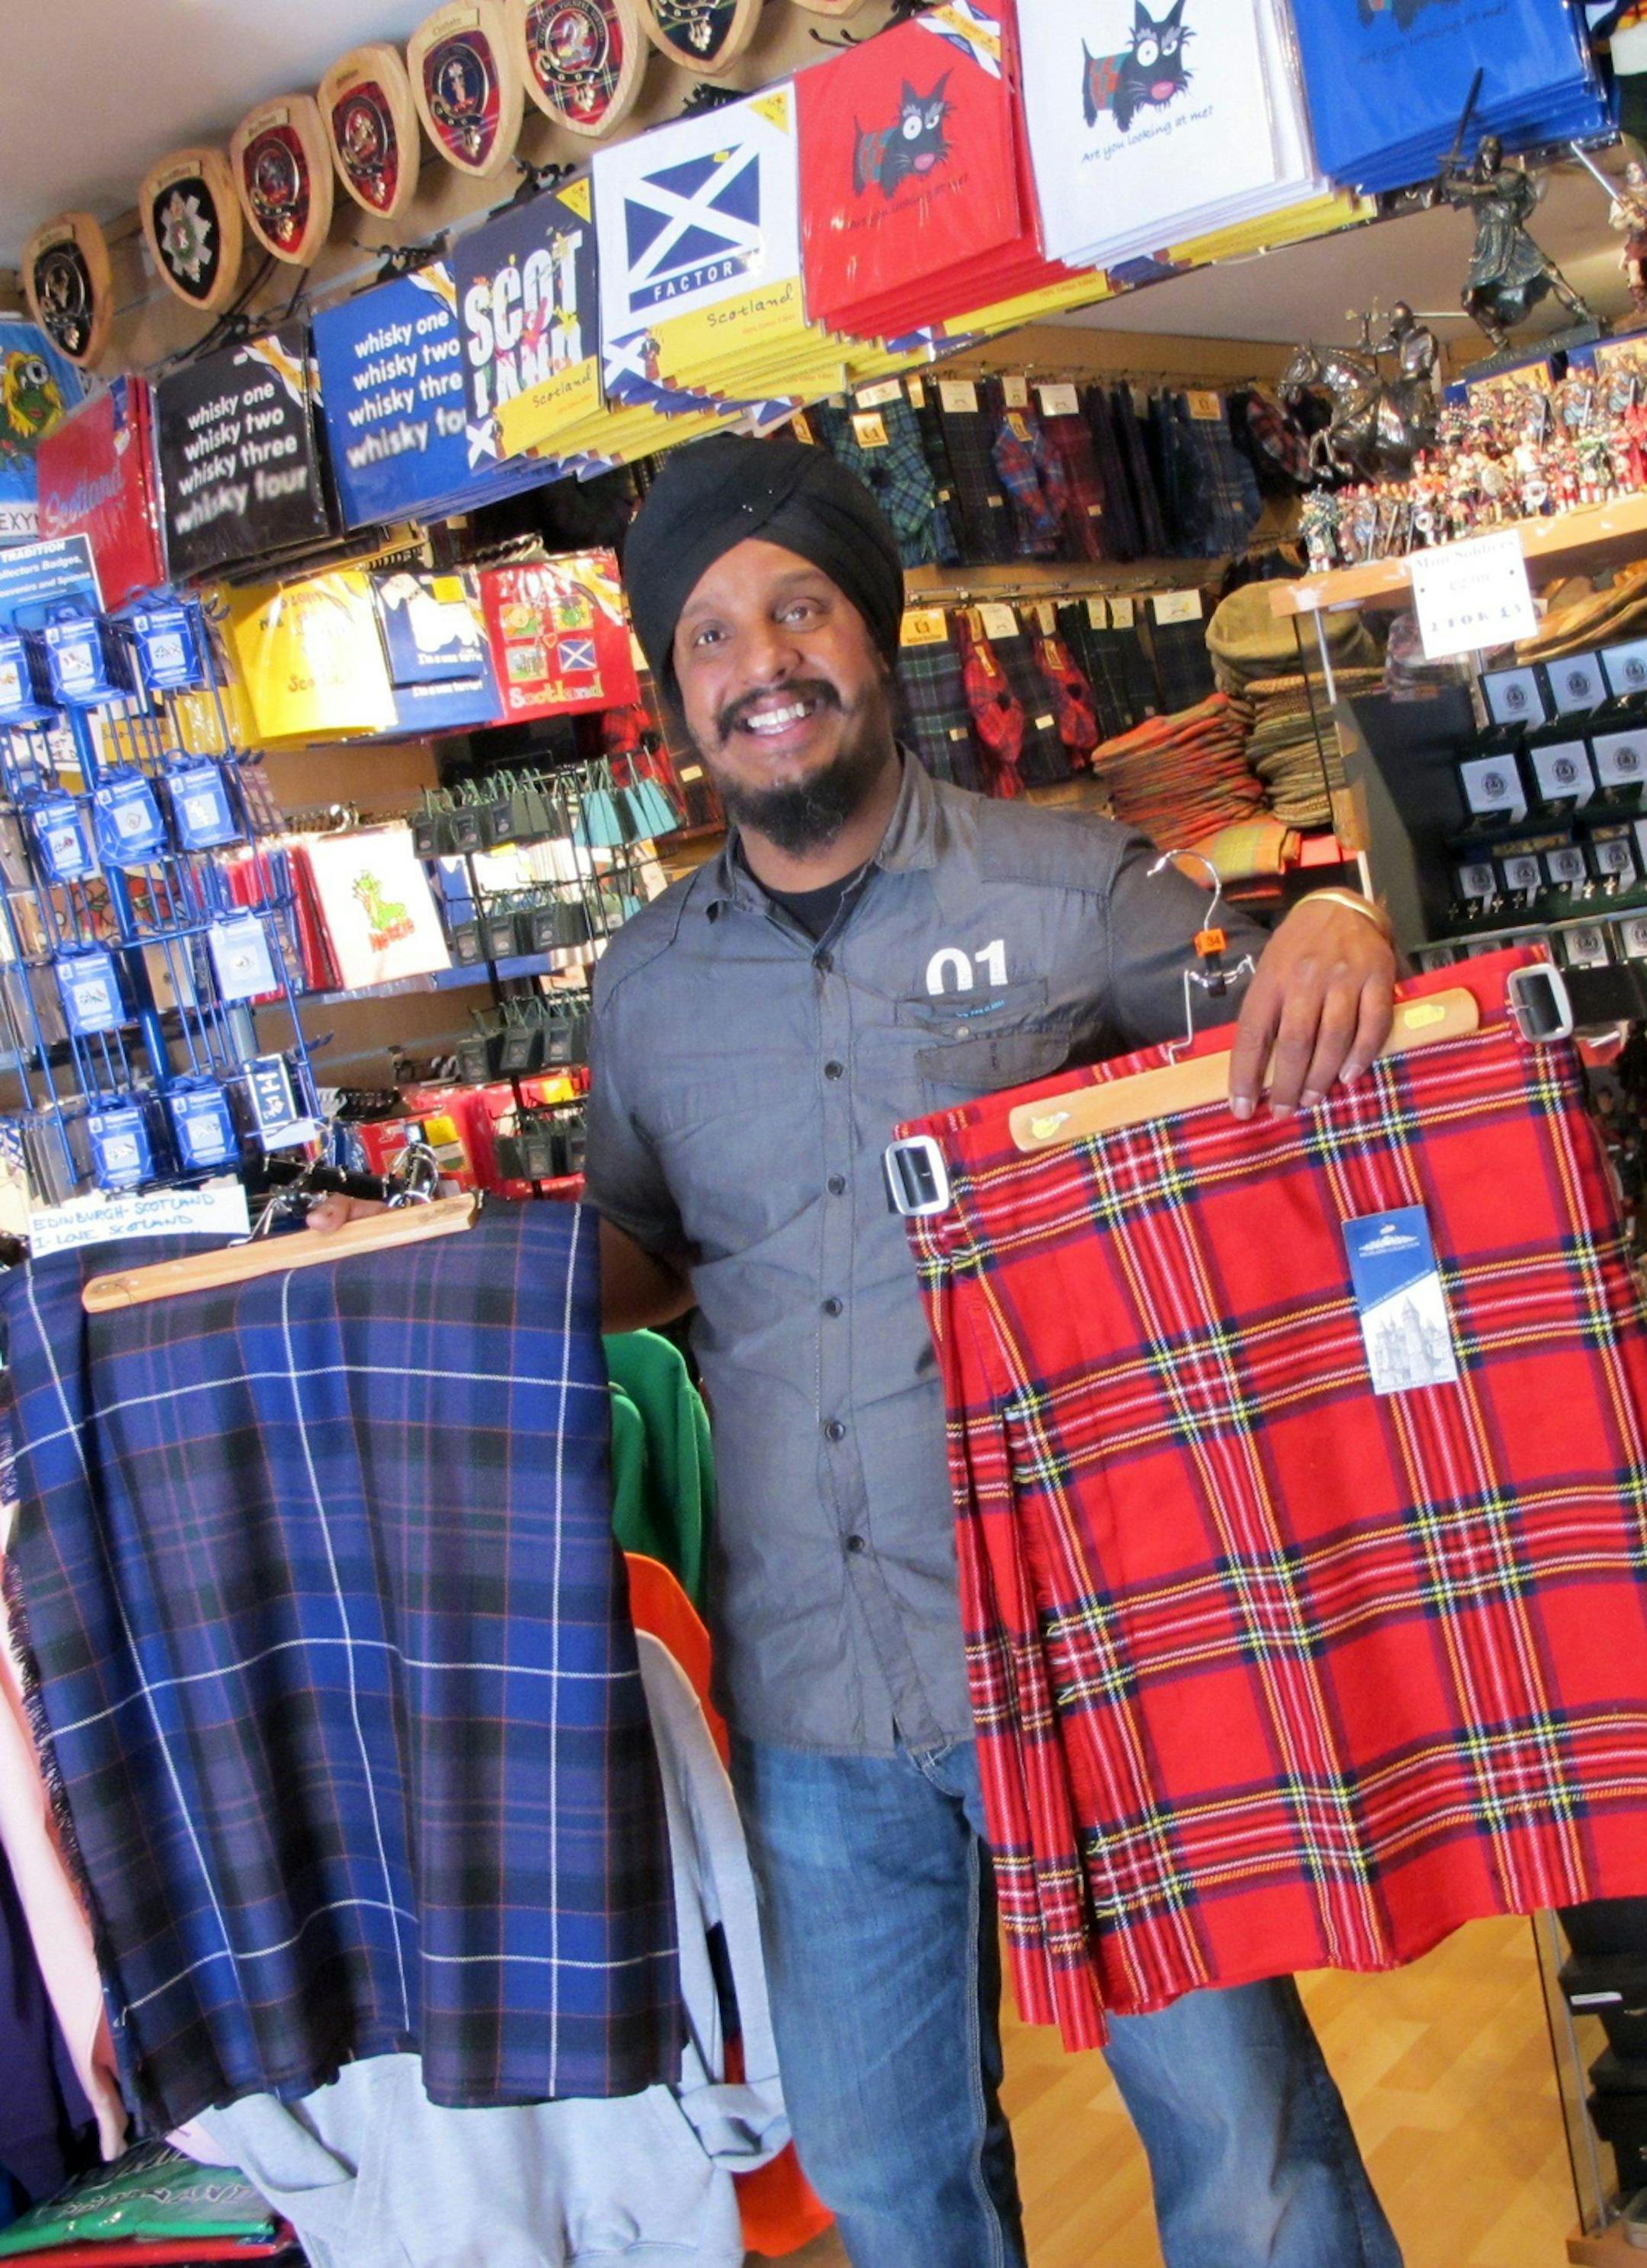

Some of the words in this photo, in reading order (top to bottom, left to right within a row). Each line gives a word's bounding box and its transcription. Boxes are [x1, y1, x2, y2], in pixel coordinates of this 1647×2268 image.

[1081, 149, 1100, 164] Are
[1103, 142, 1125, 160] you
[1127, 120, 1173, 146] looking
[1175, 115, 1186, 128] at
[1190, 104, 1213, 120] me?
[653, 262, 734, 301] FACTOR
[707, 282, 794, 328] Scotland
[354, 320, 413, 359] whisky
[416, 311, 450, 335] one
[352, 353, 418, 391] whisky
[422, 338, 461, 367] two
[532, 364, 592, 409] Scotland
[188, 394, 239, 431] whisky
[242, 381, 275, 406] one
[348, 387, 416, 428] whisky
[419, 372, 463, 401] thre
[184, 421, 241, 462] whisky
[245, 407, 285, 434] two
[345, 421, 429, 470] whisky
[435, 406, 466, 437] fo
[178, 452, 236, 496] whisky
[240, 433, 298, 468] three
[174, 482, 249, 535] whisky
[253, 464, 308, 501] four
[1, 541, 66, 563] TRADITION
[509, 671, 605, 709] Scotland
[134, 1192, 216, 1216] SCOTLAND
[56, 1229, 99, 1245] LOVE
